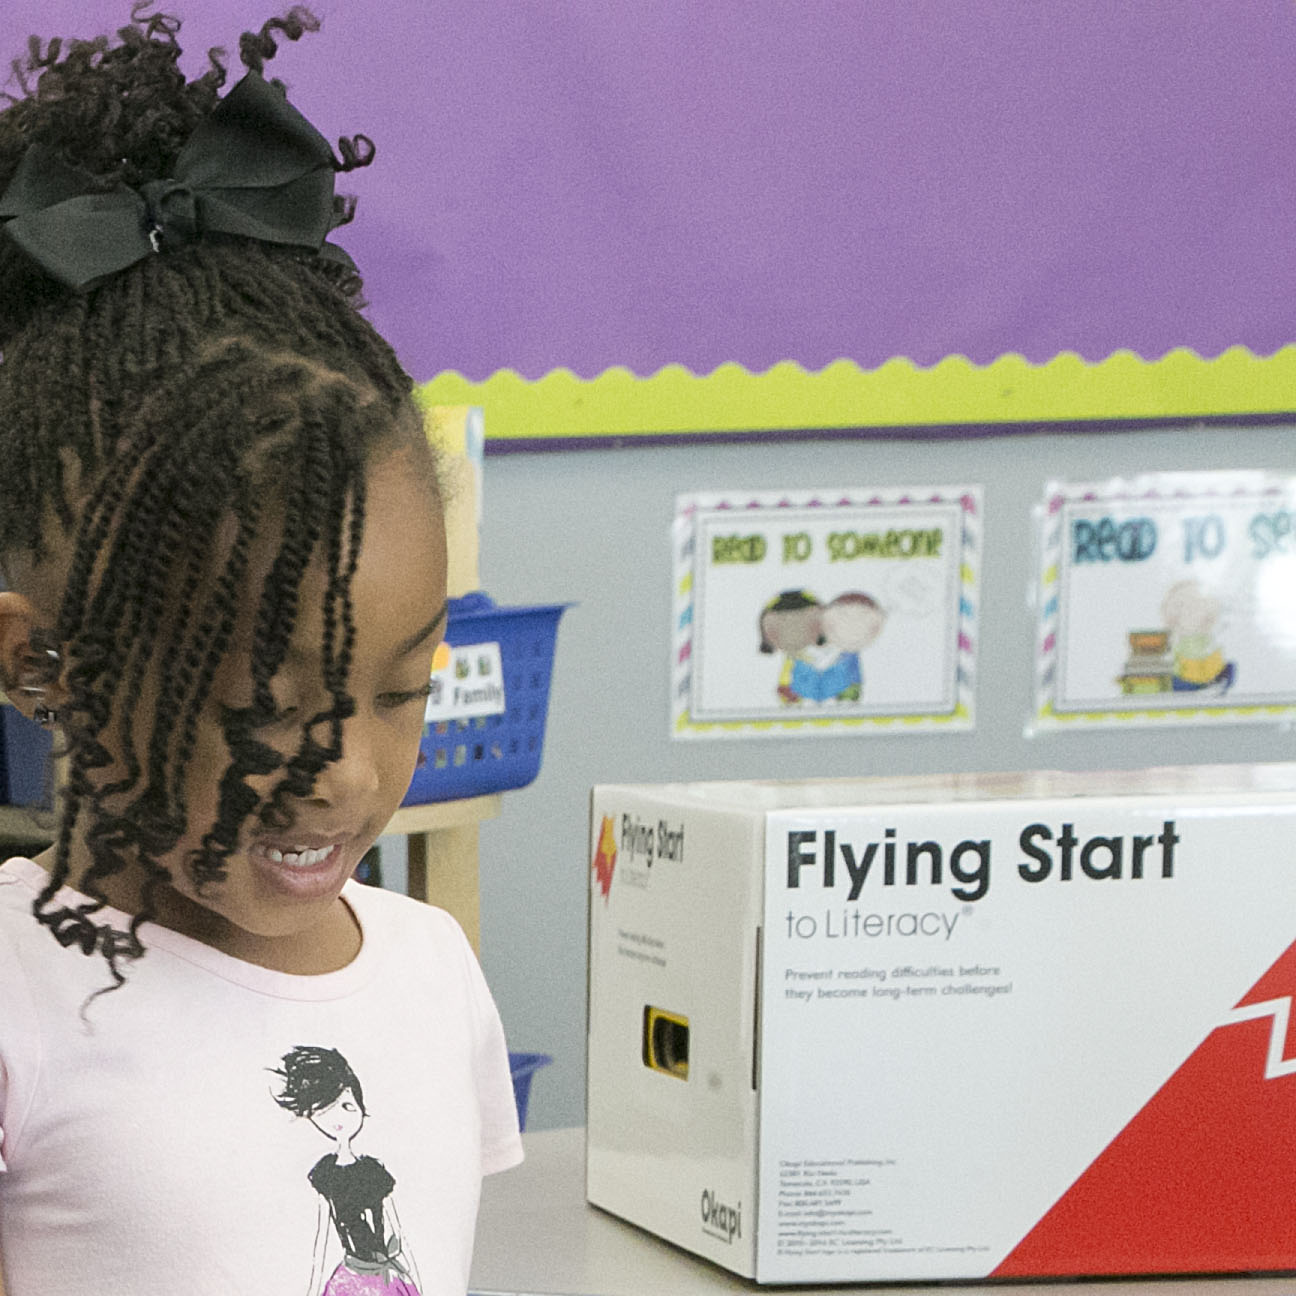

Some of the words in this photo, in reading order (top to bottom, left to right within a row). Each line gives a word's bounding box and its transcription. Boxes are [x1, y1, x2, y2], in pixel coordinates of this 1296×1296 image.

[621, 812, 655, 868] Flying
[657, 819, 685, 864] Start
[786, 827, 992, 902] Flying
[1017, 820, 1181, 883] Start
[785, 909, 817, 939] to
[784, 987, 814, 1002] they
[817, 987, 868, 999] become
[872, 985, 937, 1000] long-term
[785, 968, 833, 980] Prevent
[837, 967, 886, 981] reading
[891, 965, 954, 978] difficulties
[959, 963, 1000, 976] before
[701, 1187, 742, 1243] Okapi
